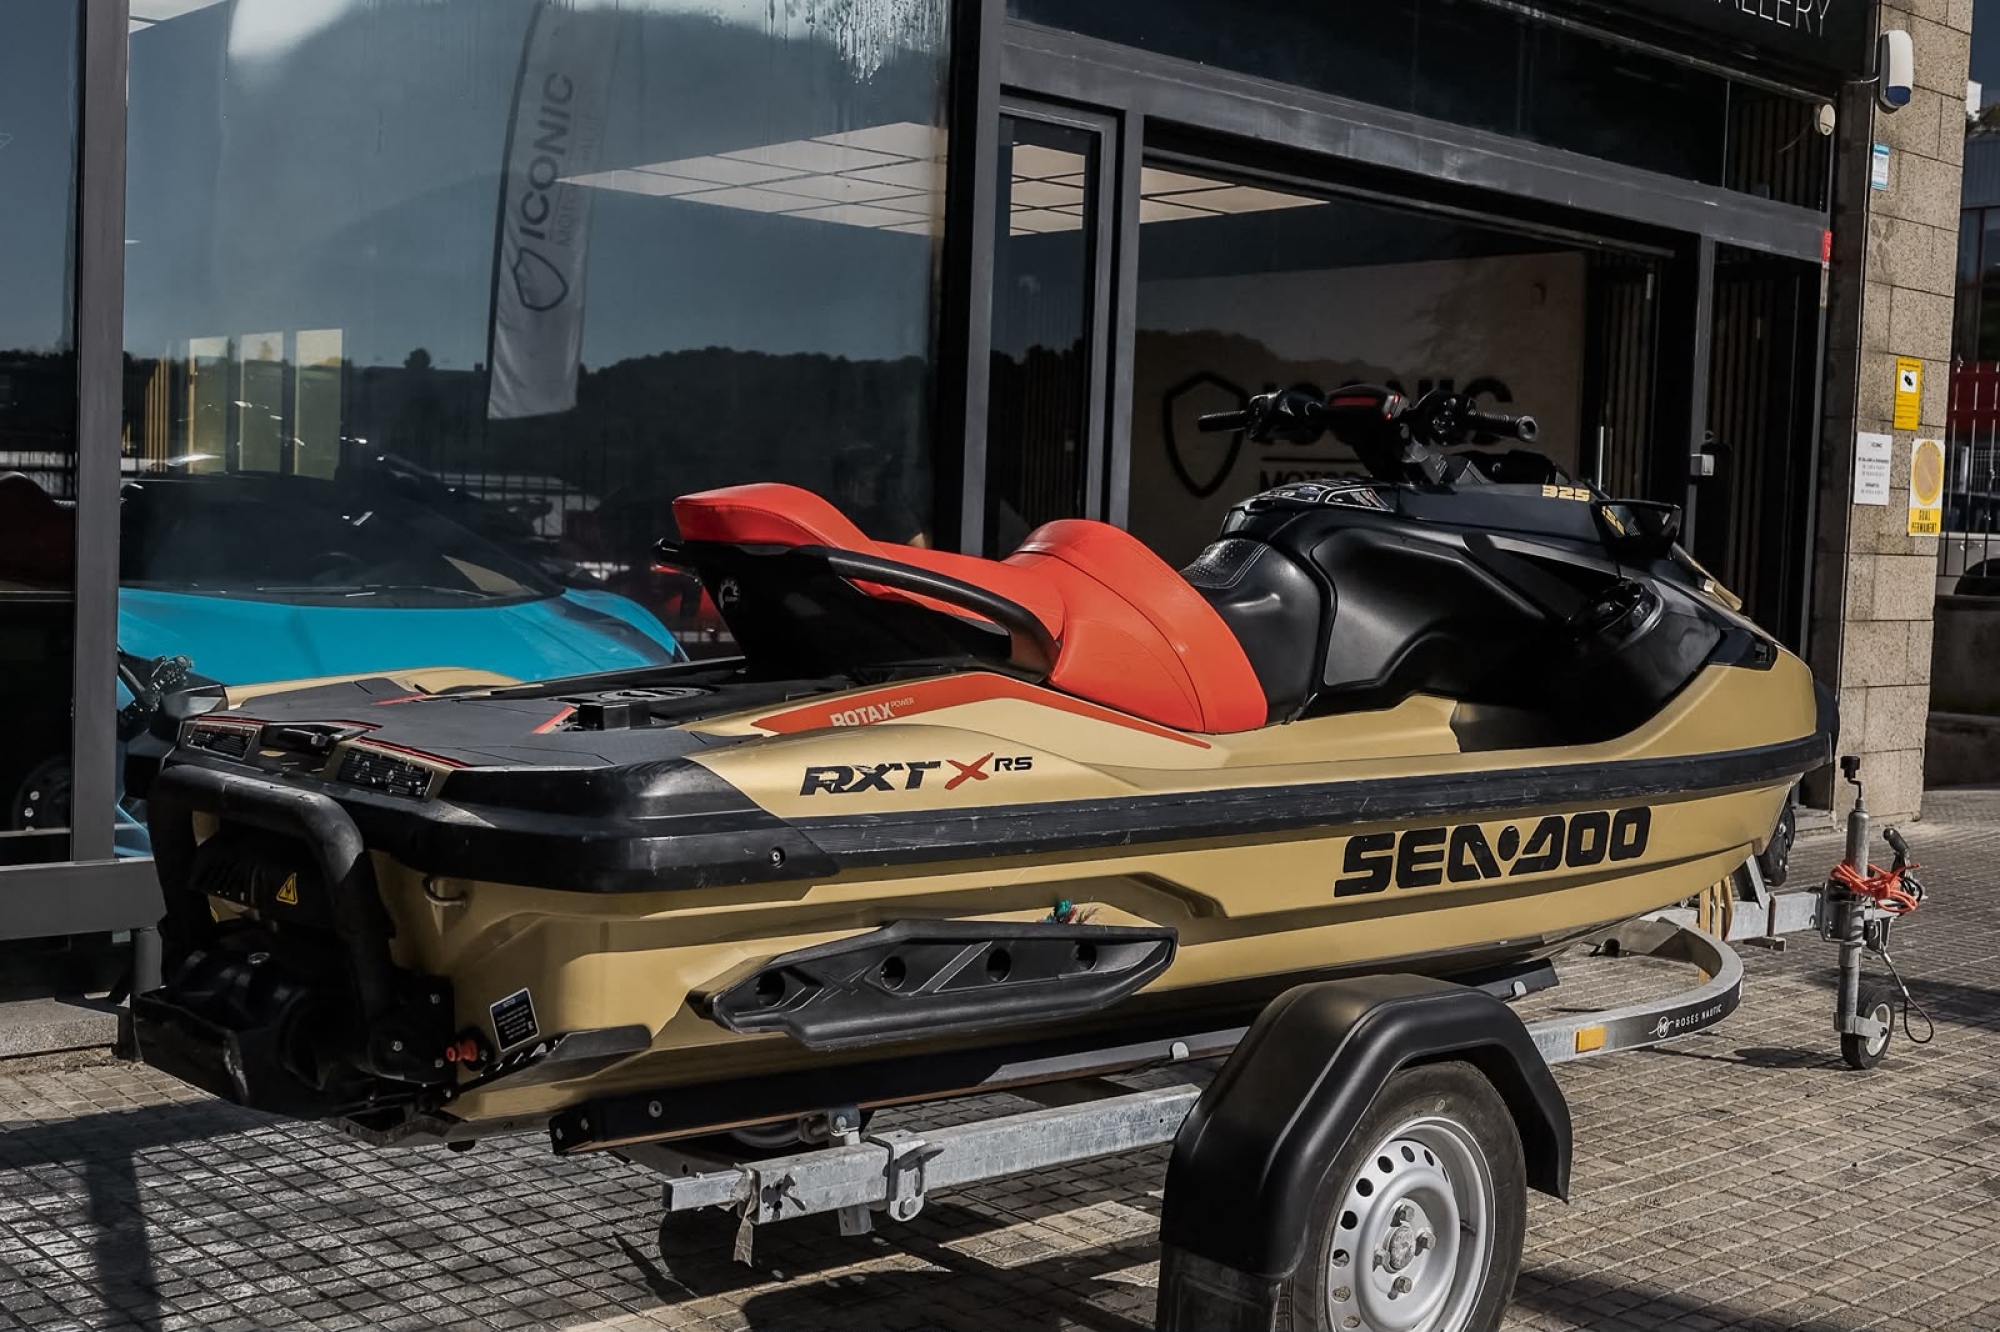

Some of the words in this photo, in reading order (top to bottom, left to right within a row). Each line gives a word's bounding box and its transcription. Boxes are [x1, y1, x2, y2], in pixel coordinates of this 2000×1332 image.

[520, 72, 574, 240] ICONIC
[1542, 484, 1591, 502] 325
[829, 701, 895, 727] ROTAX
[890, 697, 916, 708] POWER
[994, 756, 1033, 772] RS
[1675, 1012, 1699, 1028] ROSES
